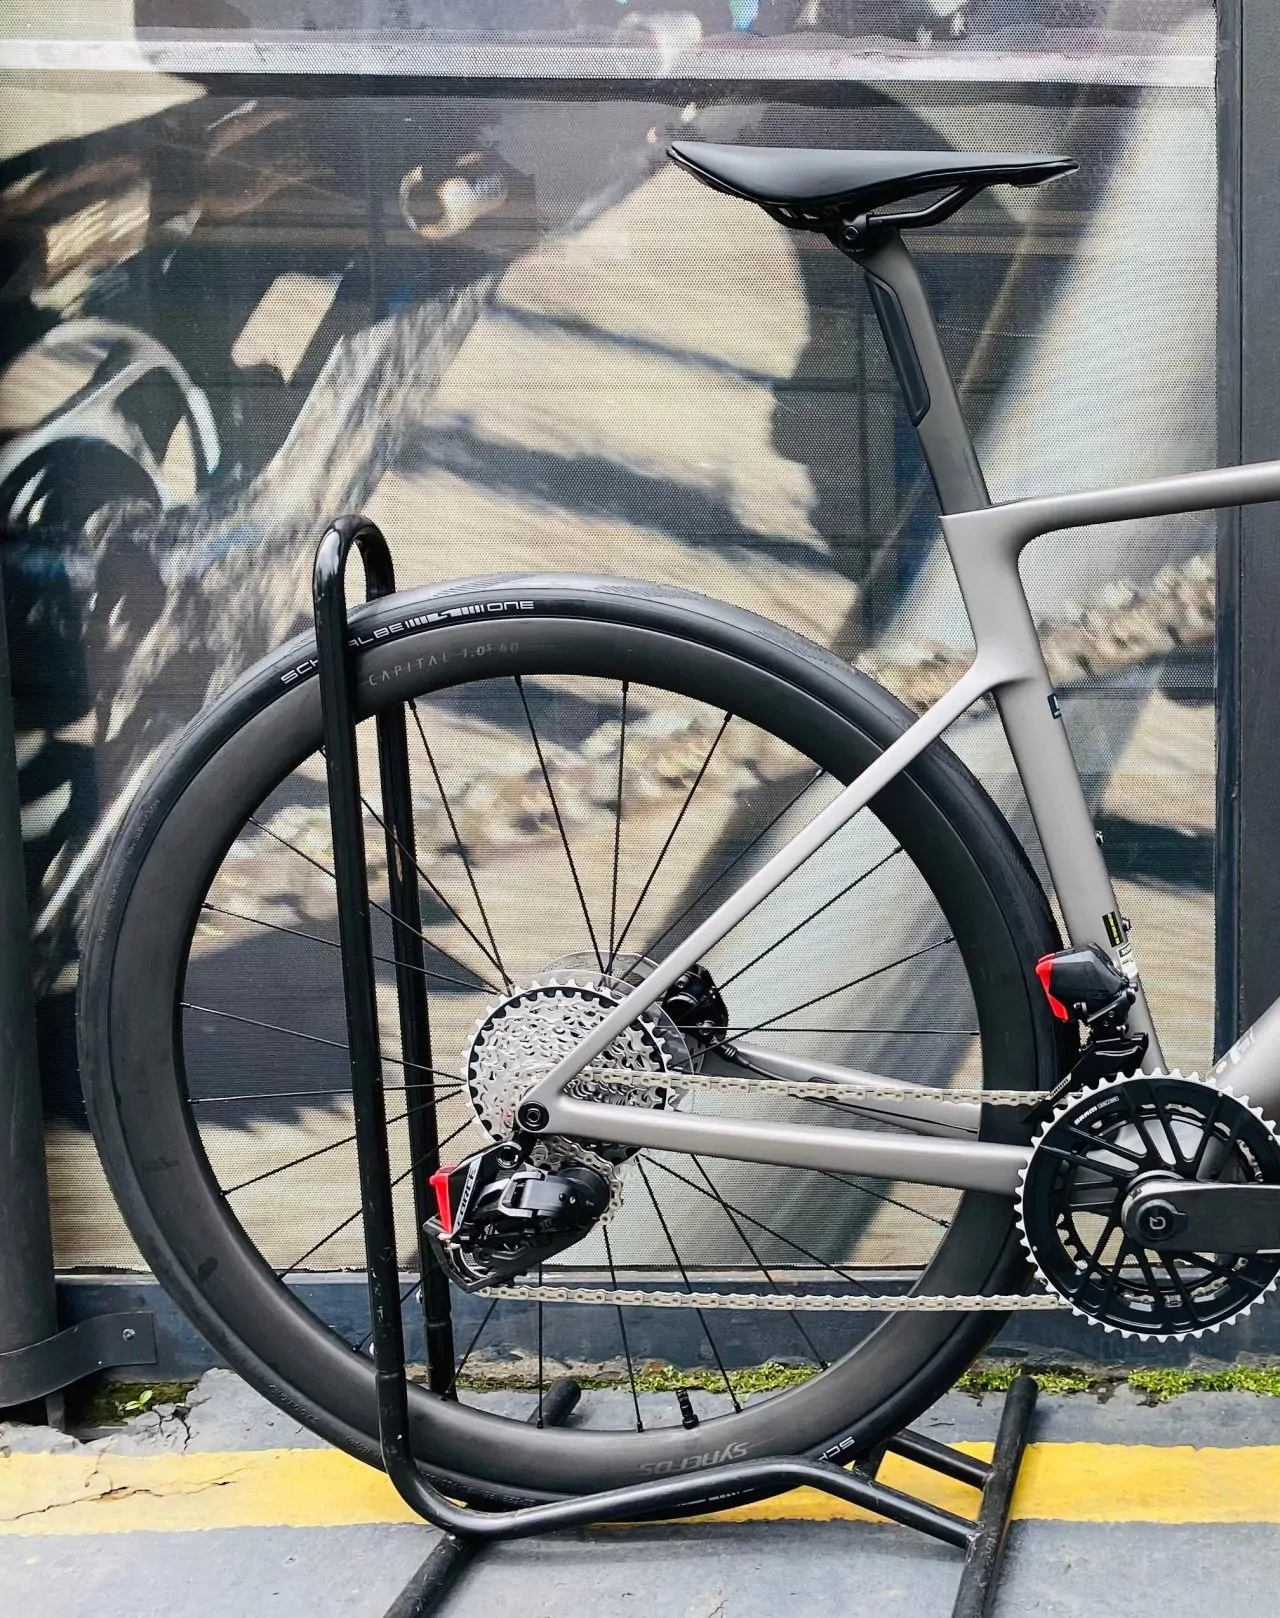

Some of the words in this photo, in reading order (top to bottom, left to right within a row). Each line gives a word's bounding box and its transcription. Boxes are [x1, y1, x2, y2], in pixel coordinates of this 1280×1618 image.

[280, 622, 404, 684] SCHALBE
[486, 600, 535, 612] ONE
[368, 652, 450, 686] CAPITAL
